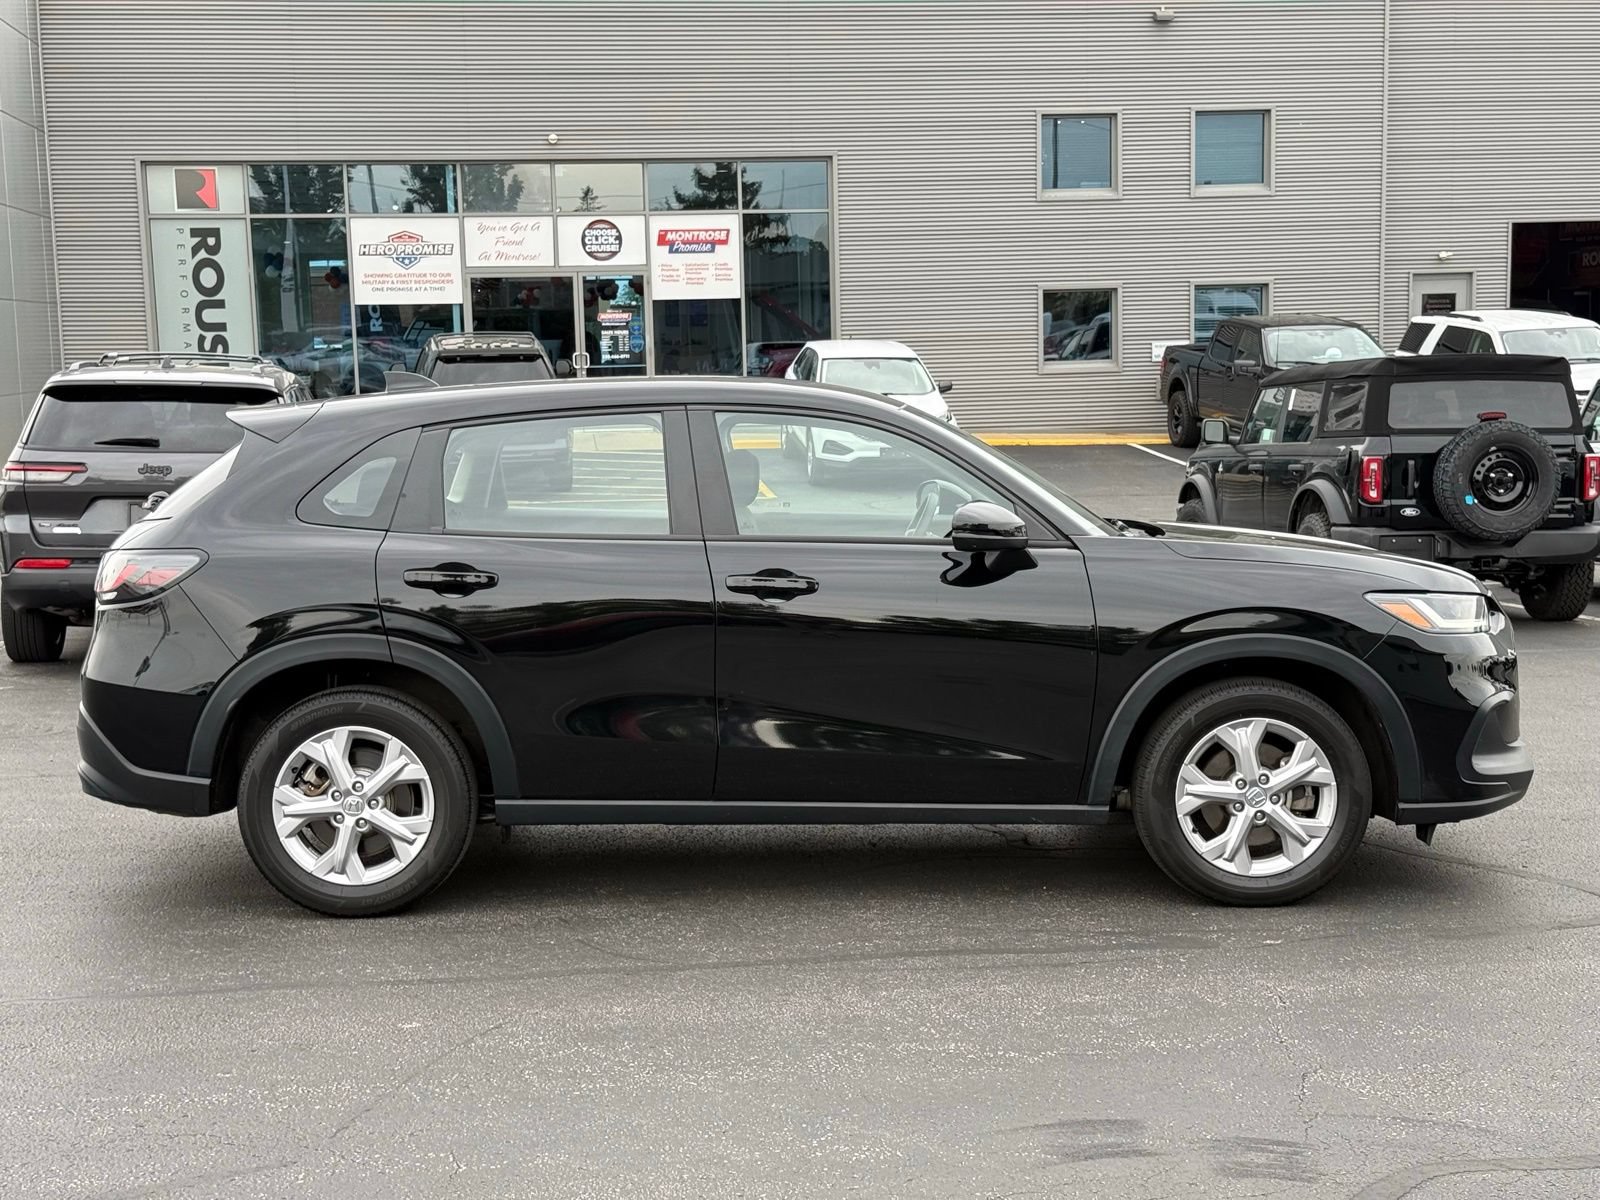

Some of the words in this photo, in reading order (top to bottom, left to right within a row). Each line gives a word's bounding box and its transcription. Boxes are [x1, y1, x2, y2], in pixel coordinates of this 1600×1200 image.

[584, 236, 619, 245] CLICK.
[665, 230, 728, 241] MONTROSE
[494, 236, 526, 247] Friend
[672, 241, 712, 252] Promise
[359, 243, 396, 256] HERO
[396, 243, 454, 256] PROMISE
[585, 244, 620, 252] CRUISE!
[189, 227, 230, 367] ROUS
[137, 463, 173, 477] Jeep
